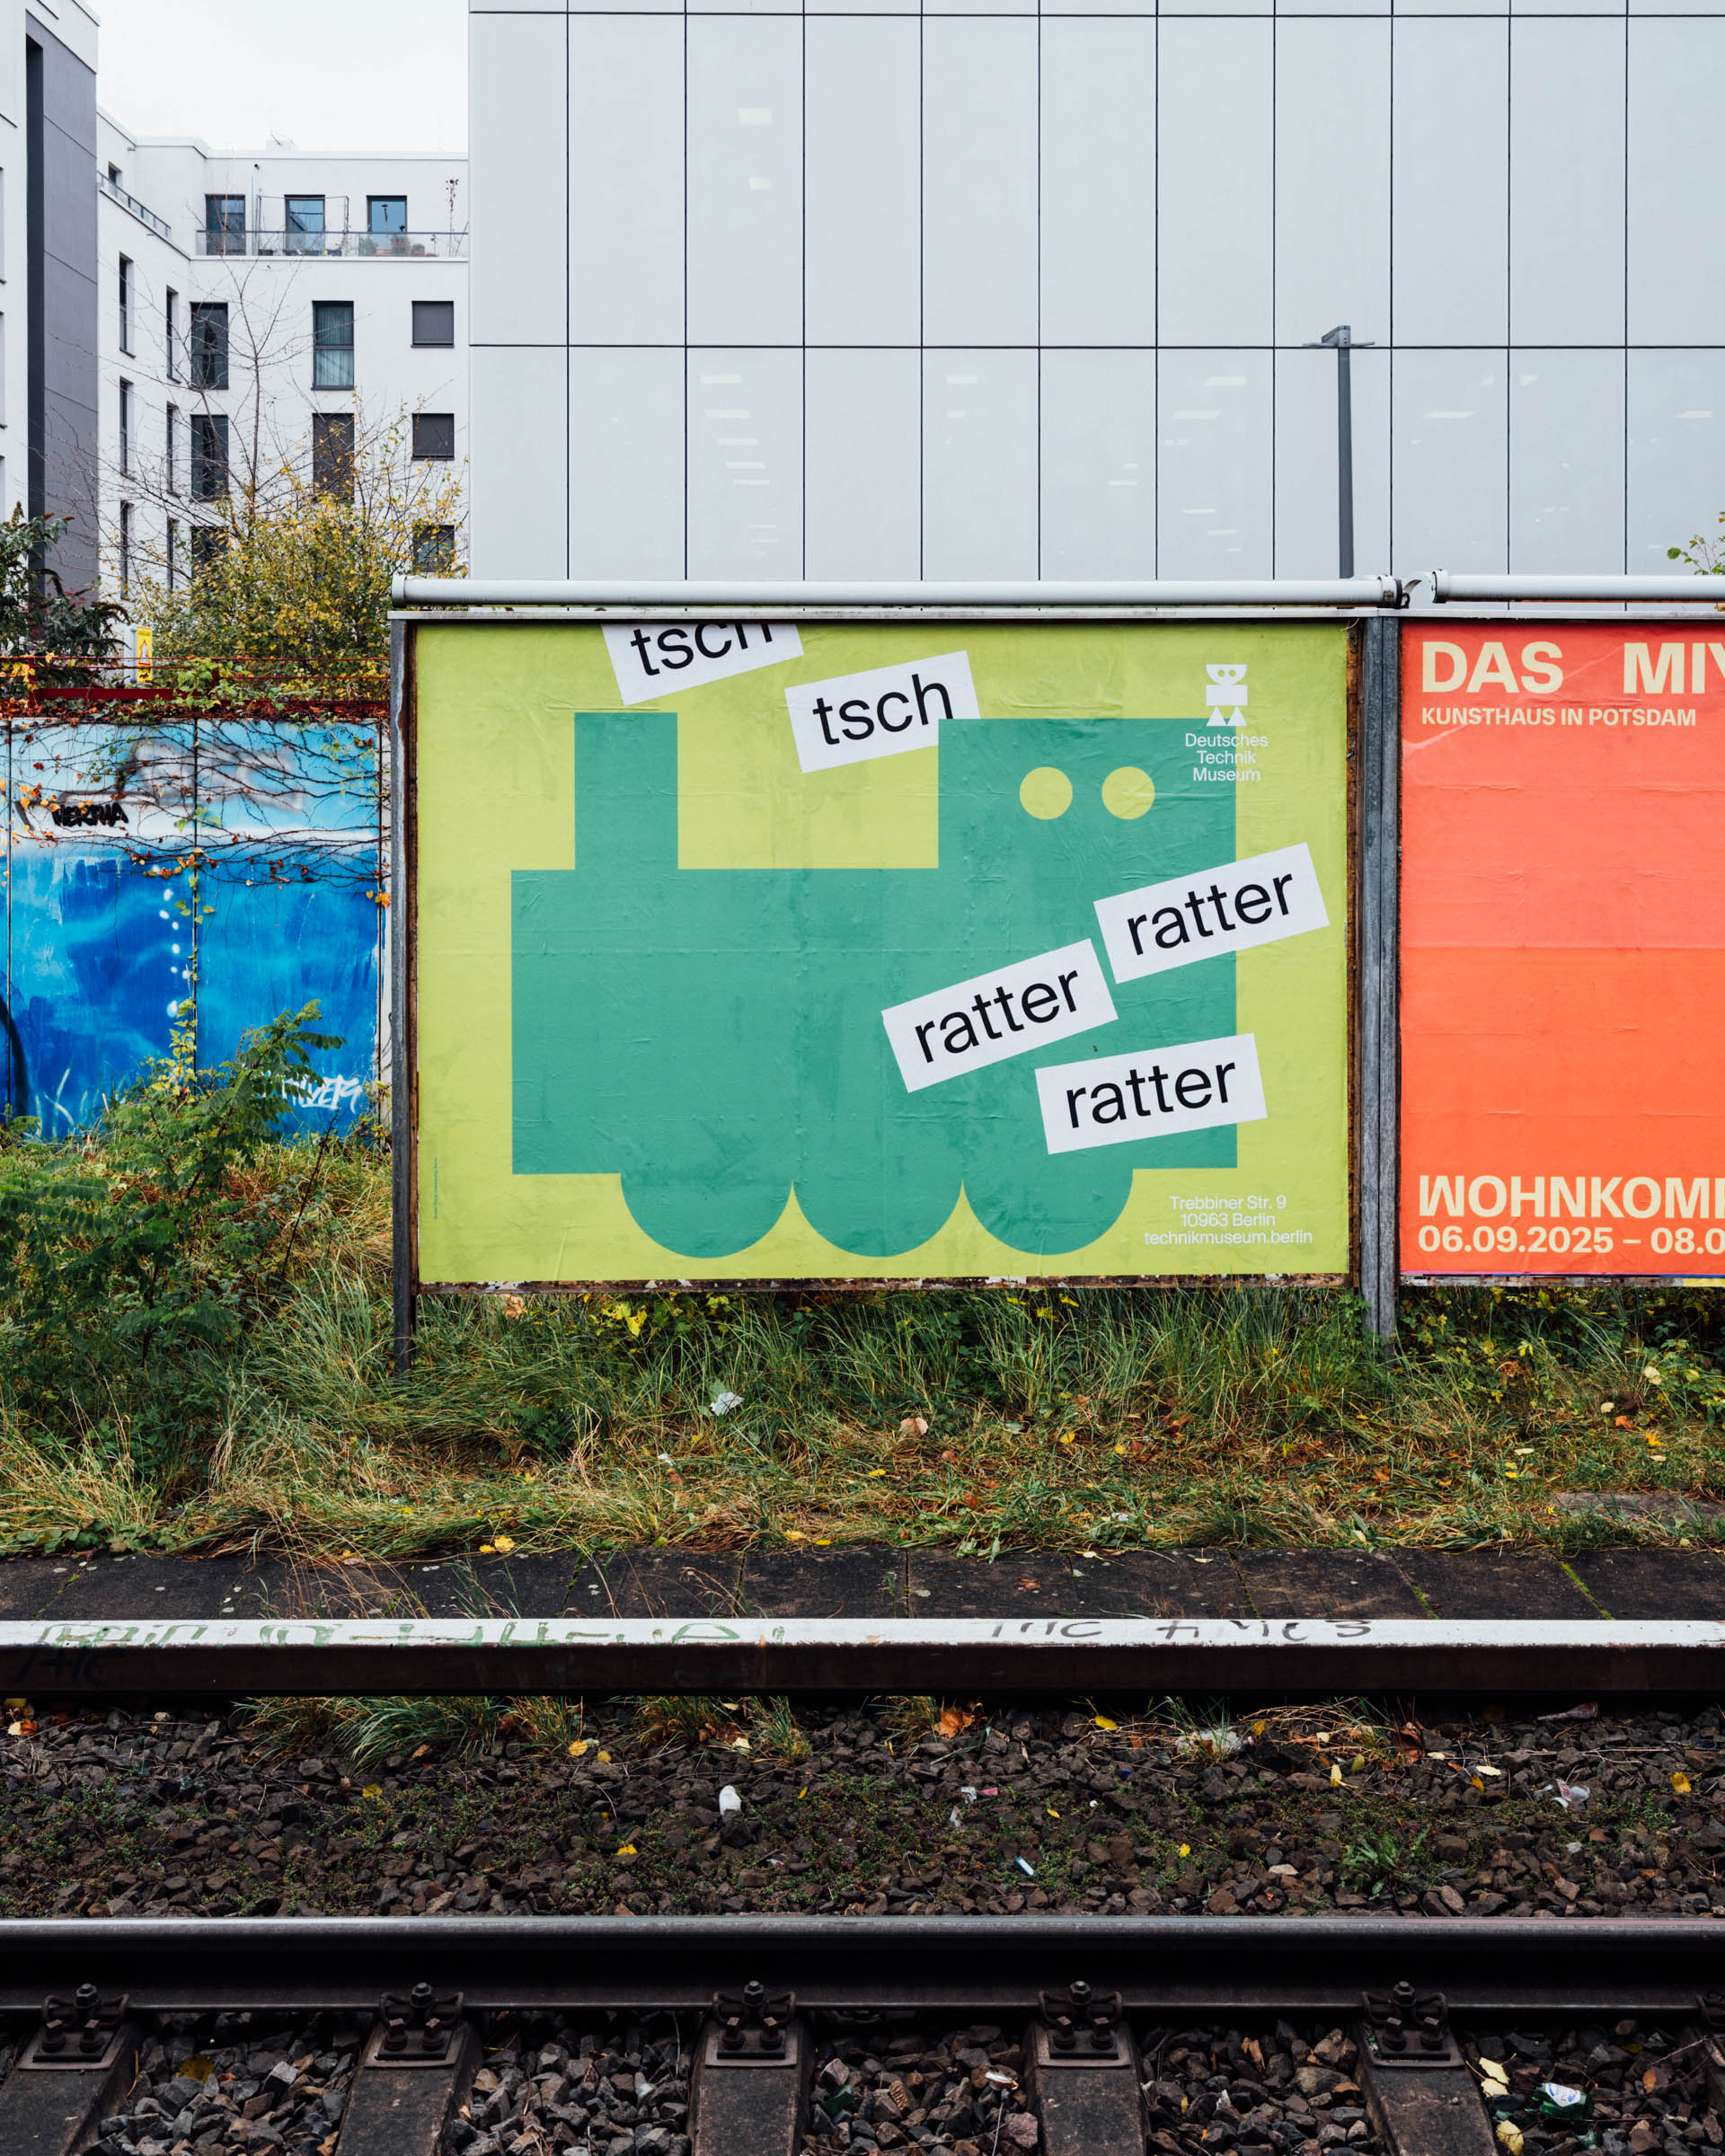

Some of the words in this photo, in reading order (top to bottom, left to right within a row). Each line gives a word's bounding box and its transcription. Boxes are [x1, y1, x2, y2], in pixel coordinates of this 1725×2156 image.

[1421, 641, 1564, 694] DAS
[812, 674, 954, 746] tsch
[1421, 707, 1556, 726] KUNSTHAUS
[1561, 708, 1583, 726] IN
[1588, 708, 1696, 727] POTSDAM
[1185, 732, 1269, 747] Deutsches
[1196, 749, 1257, 764] Technik
[1192, 766, 1261, 782] Museum
[1127, 873, 1294, 956] ratter
[914, 970, 1079, 1064] ratter
[1066, 1062, 1236, 1129] ratter
[1169, 1195, 1244, 1210] Trebbiner
[1246, 1194, 1273, 1210] Str.
[1276, 1194, 1287, 1210] 9
[1181, 1212, 1229, 1228] 10963
[1232, 1212, 1277, 1228] Berlin
[1144, 1229, 1314, 1246] technikmuseum.berlin
[1418, 1224, 1614, 1254] 06.09.2025
